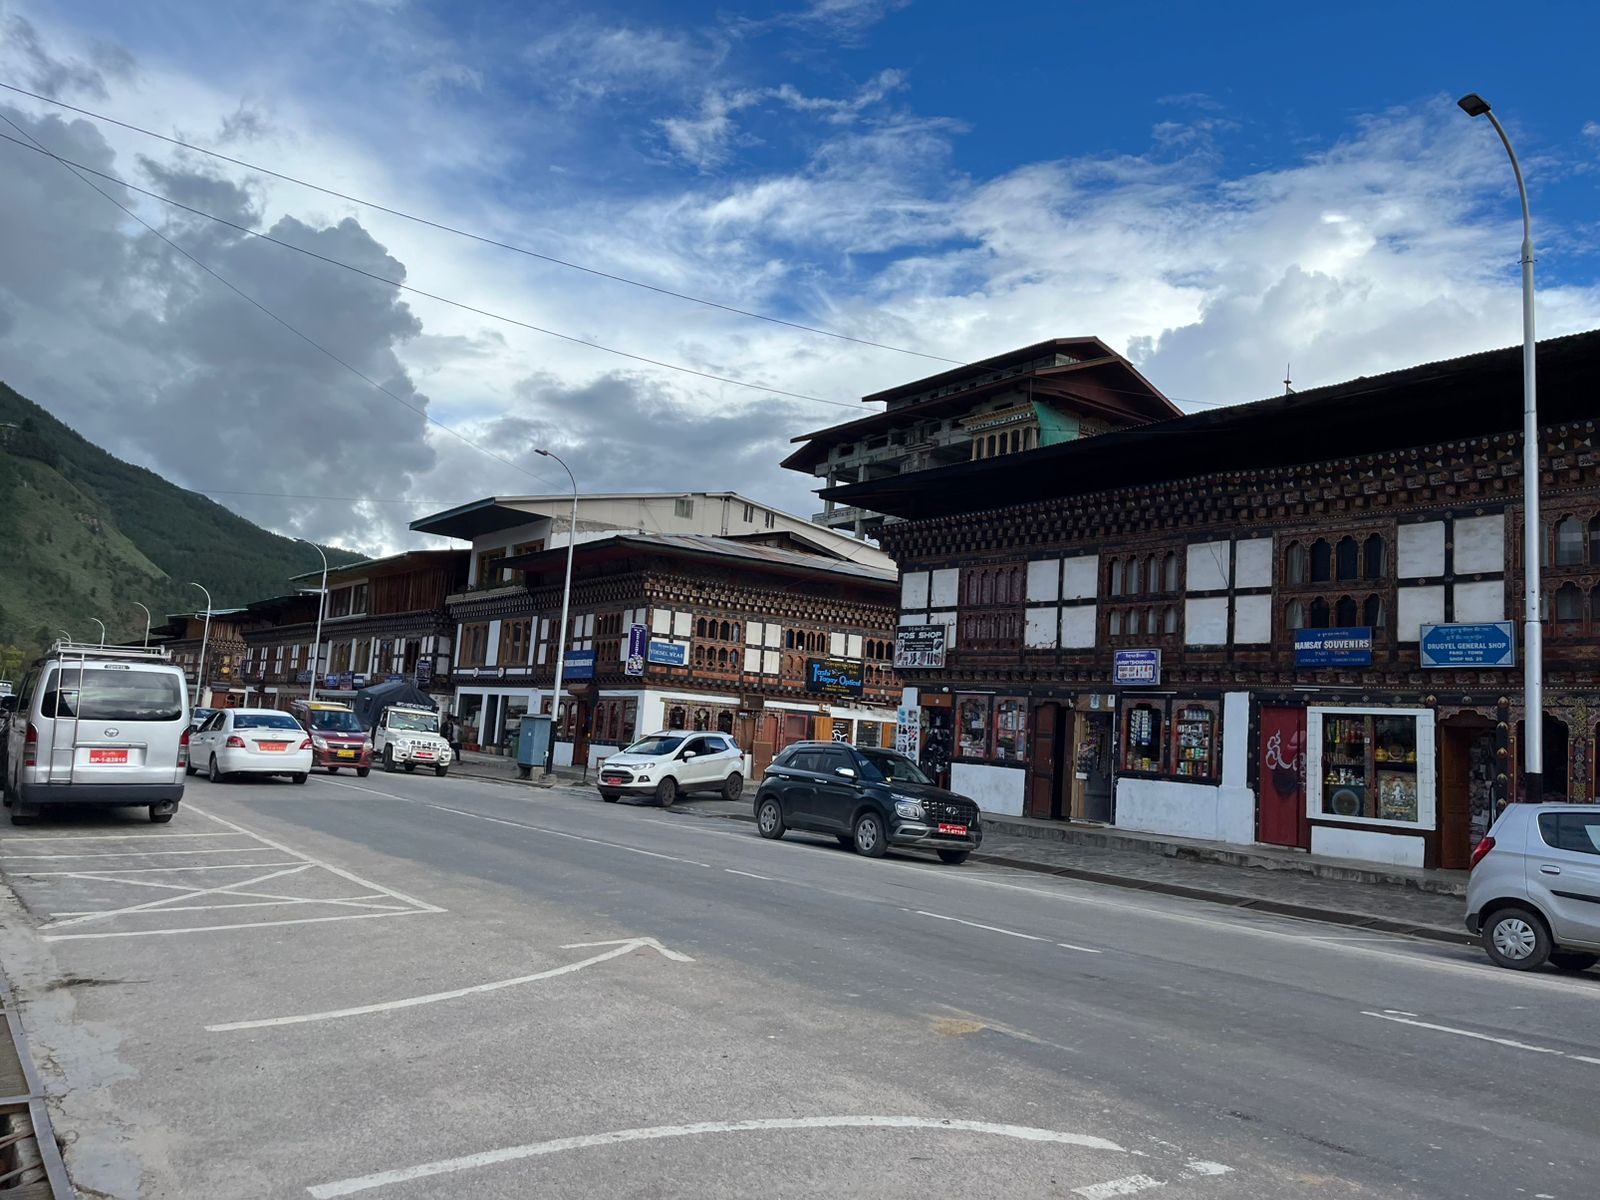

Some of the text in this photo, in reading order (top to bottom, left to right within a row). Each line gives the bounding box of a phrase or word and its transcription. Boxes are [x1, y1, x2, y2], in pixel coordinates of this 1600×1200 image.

[918, 631, 943, 639] SHOP
[1323, 640, 1370, 649] SOUVENIRS
[839, 675, 862, 687] Optical
